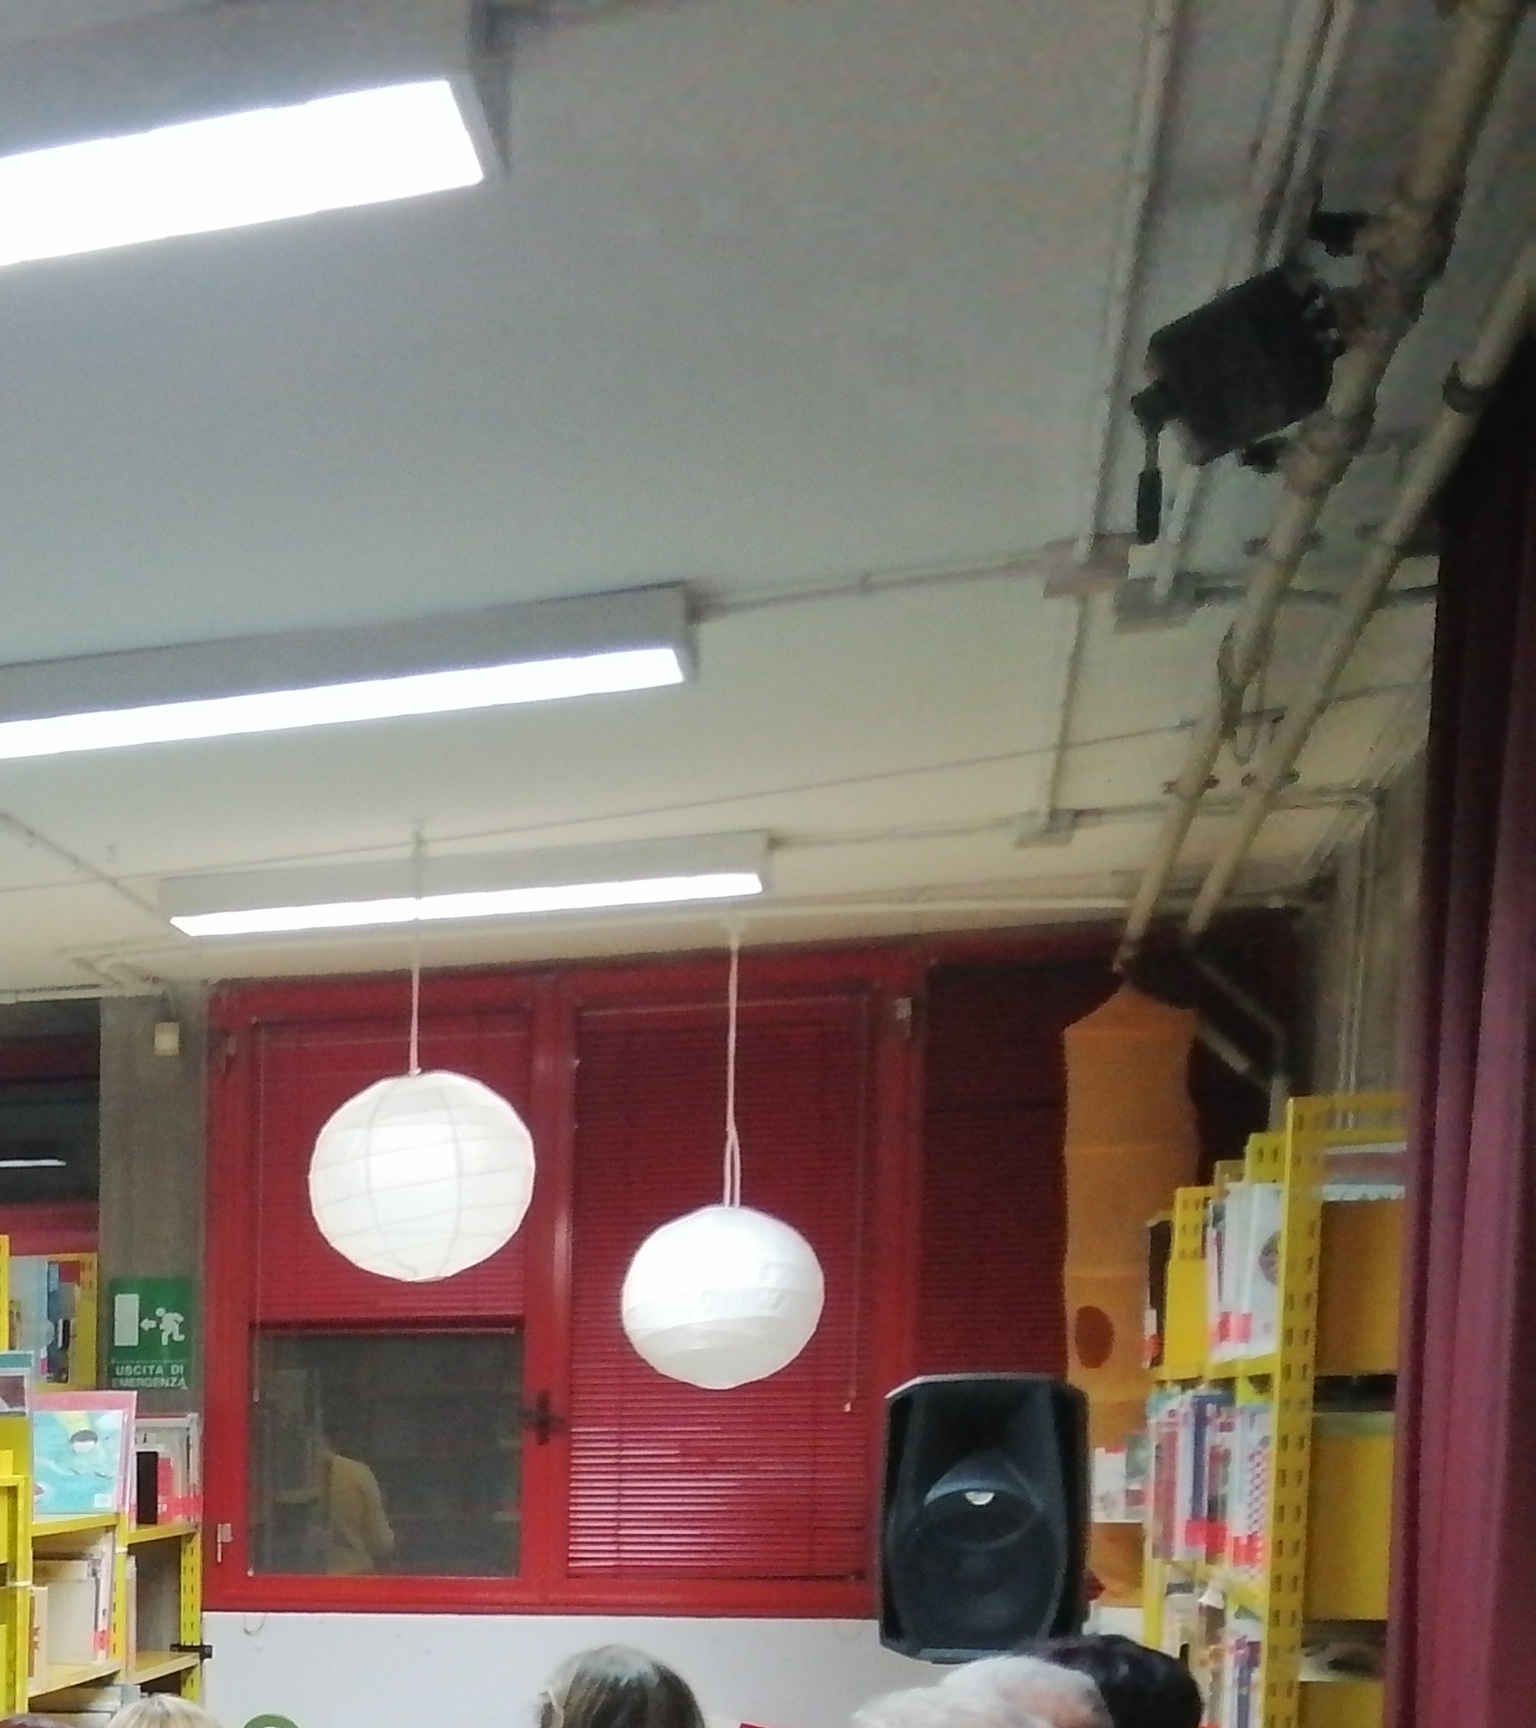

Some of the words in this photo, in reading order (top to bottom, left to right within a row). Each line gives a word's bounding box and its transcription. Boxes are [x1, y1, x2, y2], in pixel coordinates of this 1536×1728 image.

[115, 1365, 164, 1377] USCITA
[170, 1364, 185, 1376] DI
[112, 1376, 187, 1389] EMERGENZA
